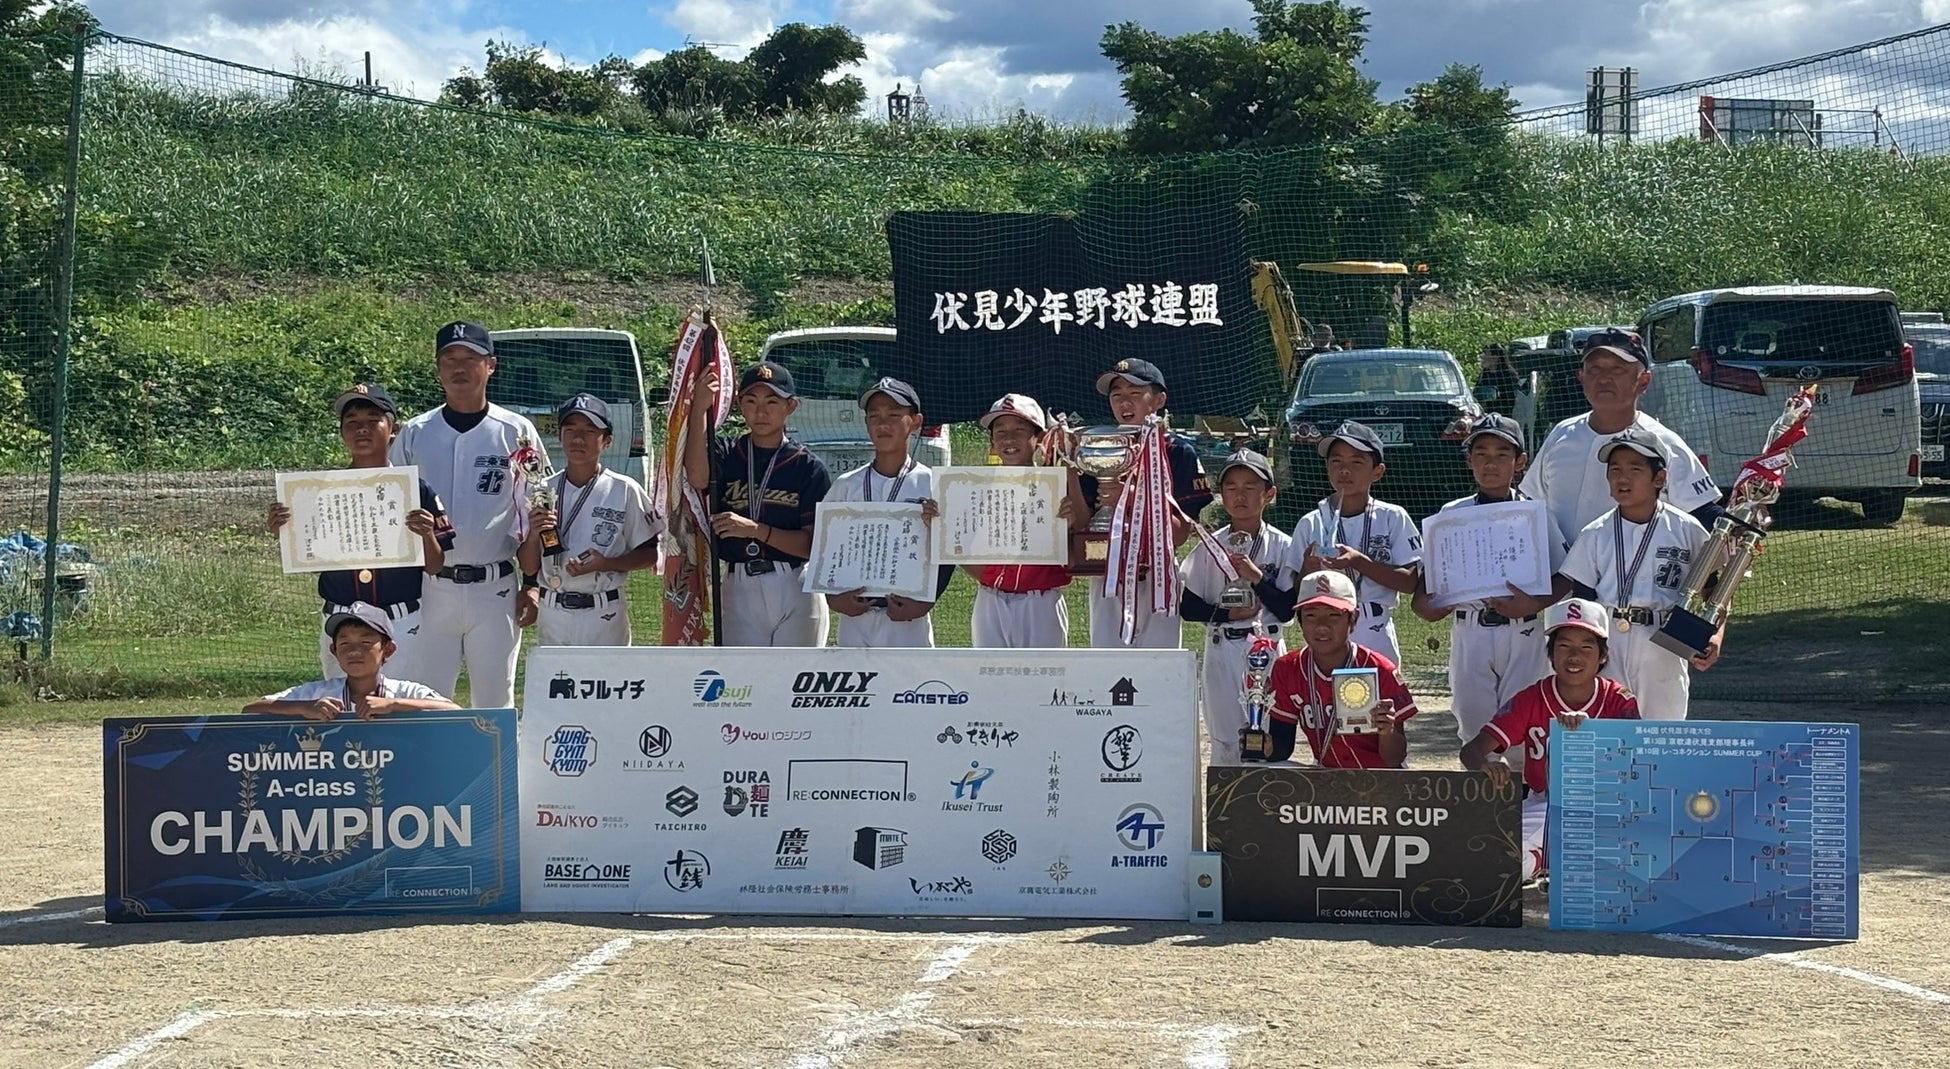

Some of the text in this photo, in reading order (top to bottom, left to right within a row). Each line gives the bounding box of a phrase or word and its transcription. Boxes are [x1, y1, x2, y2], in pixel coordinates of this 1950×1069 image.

[929, 280, 1224, 336] 伏見少年野球連盟
[580, 679, 645, 700] マルイチ
[791, 672, 879, 693] ONLY
[791, 697, 871, 708] GENERAL
[892, 693, 969, 704] CARSTEP
[1076, 708, 1113, 716] WAGAYA
[551, 730, 591, 744] SWAG
[554, 745, 587, 759] GYM
[227, 749, 394, 772] SUMMER CUP
[550, 759, 588, 772] KYOTO
[622, 760, 685, 769] NIIDAYA
[723, 771, 770, 783] DURA
[266, 778, 356, 798] A-class
[941, 802, 1003, 812] Ikusei Trust
[1279, 804, 1448, 827] SUMMER CUP
[150, 804, 472, 856] CHAMPION
[654, 823, 707, 831] TAICHIRO
[775, 856, 808, 866] KEIAI
[1111, 855, 1168, 868] A-TRAFFIC
[1298, 833, 1430, 879] MVP
[545, 864, 631, 878] BASE ONE
